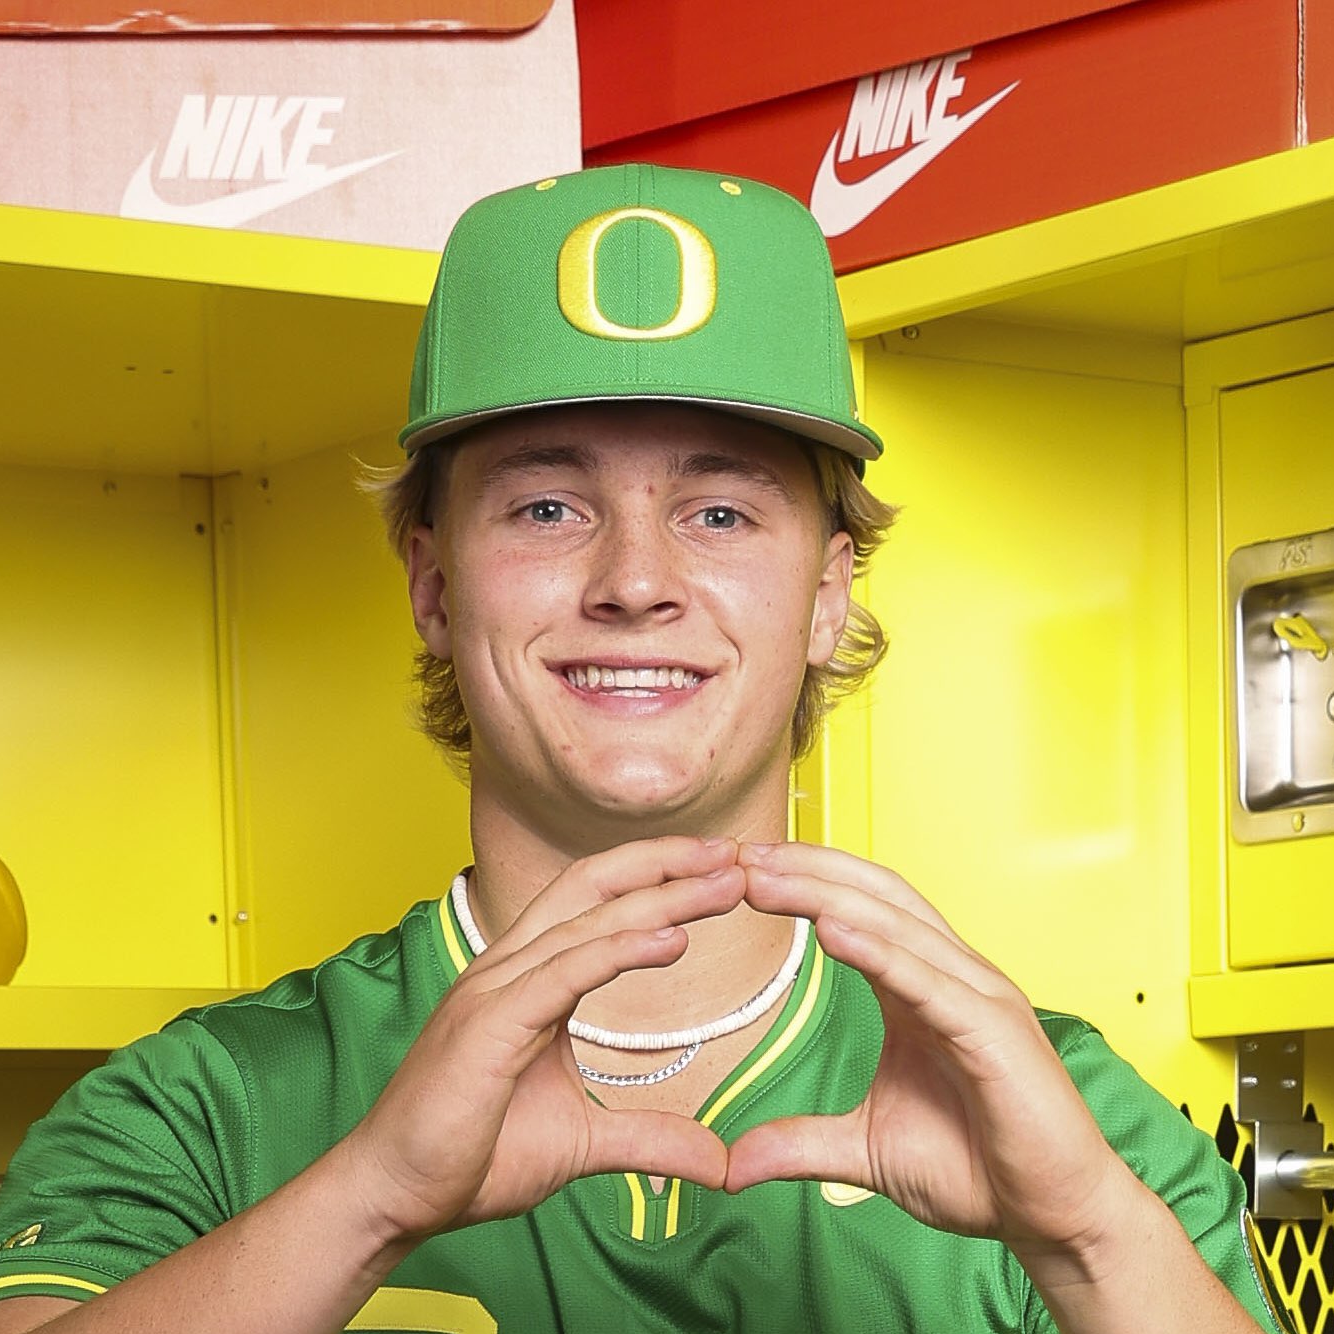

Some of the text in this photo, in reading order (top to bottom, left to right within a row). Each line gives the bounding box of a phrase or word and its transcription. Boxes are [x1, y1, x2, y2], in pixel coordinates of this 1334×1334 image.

[158, 94, 346, 184] NIKE
[838, 46, 973, 163] NIKE
[558, 207, 718, 342] O
